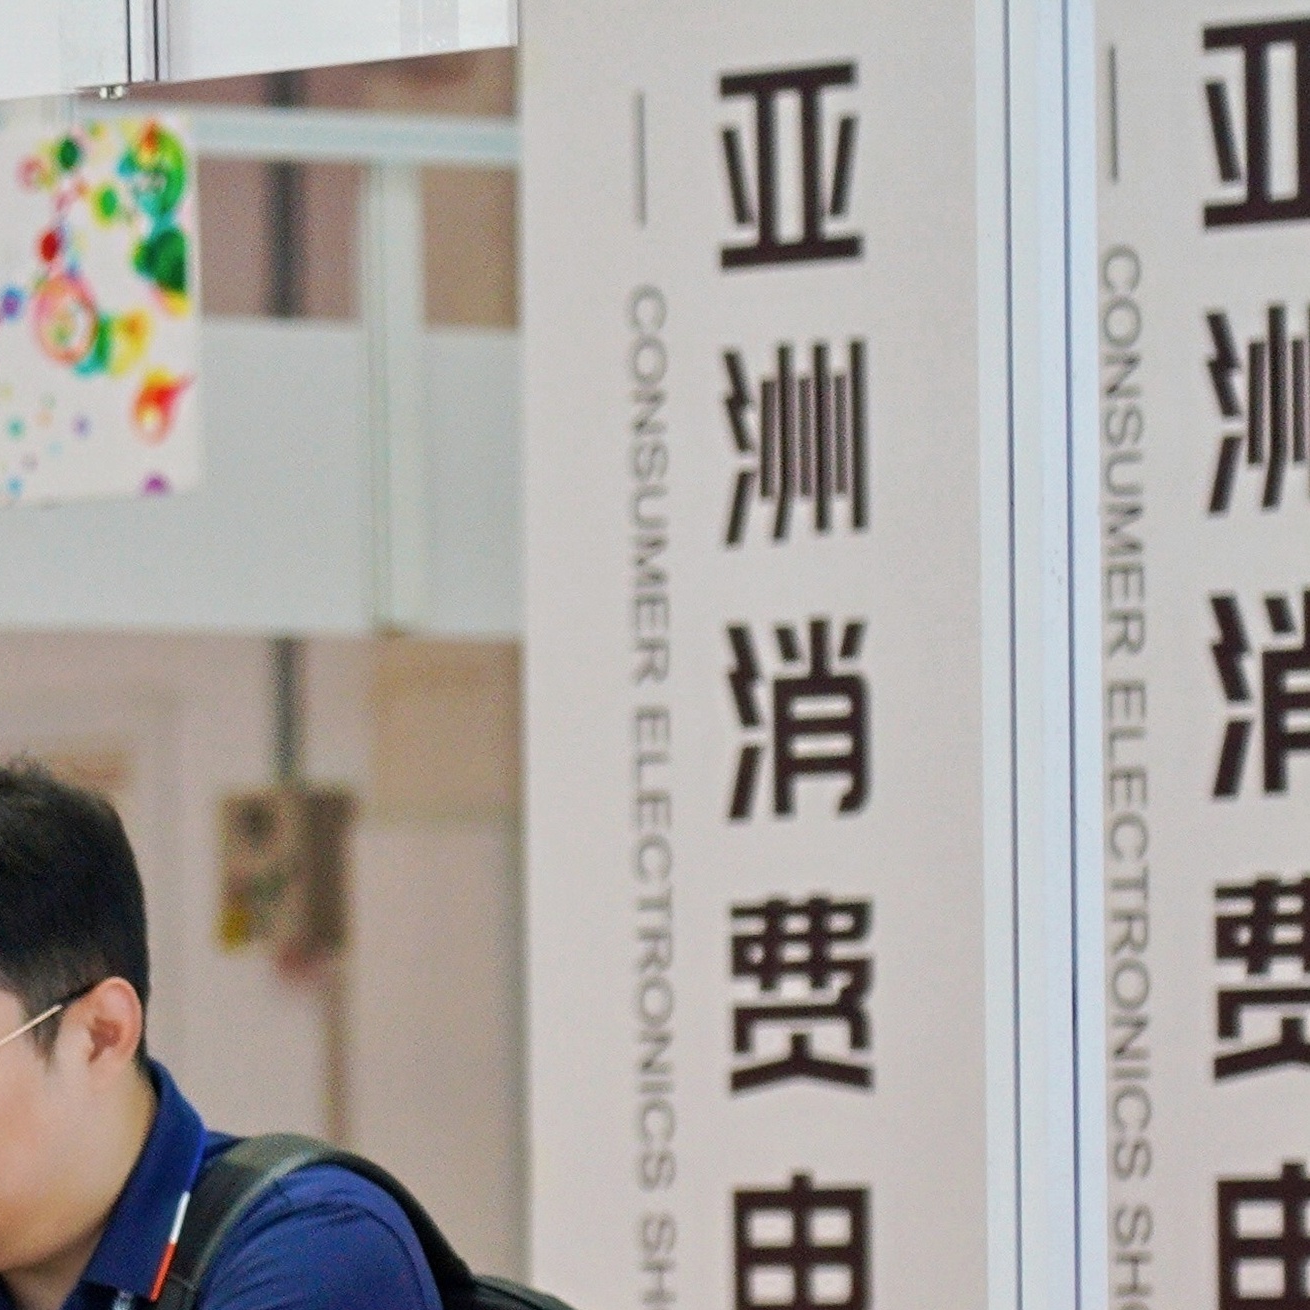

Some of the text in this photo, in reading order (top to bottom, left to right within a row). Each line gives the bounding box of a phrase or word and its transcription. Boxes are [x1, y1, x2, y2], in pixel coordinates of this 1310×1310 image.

[628, 282, 672, 686] CONSUMER
[1100, 243, 1146, 656] CONSUMER
[633, 704, 678, 1193] ELECTRONICS
[1107, 680, 1153, 1182] ELECTRONICS
